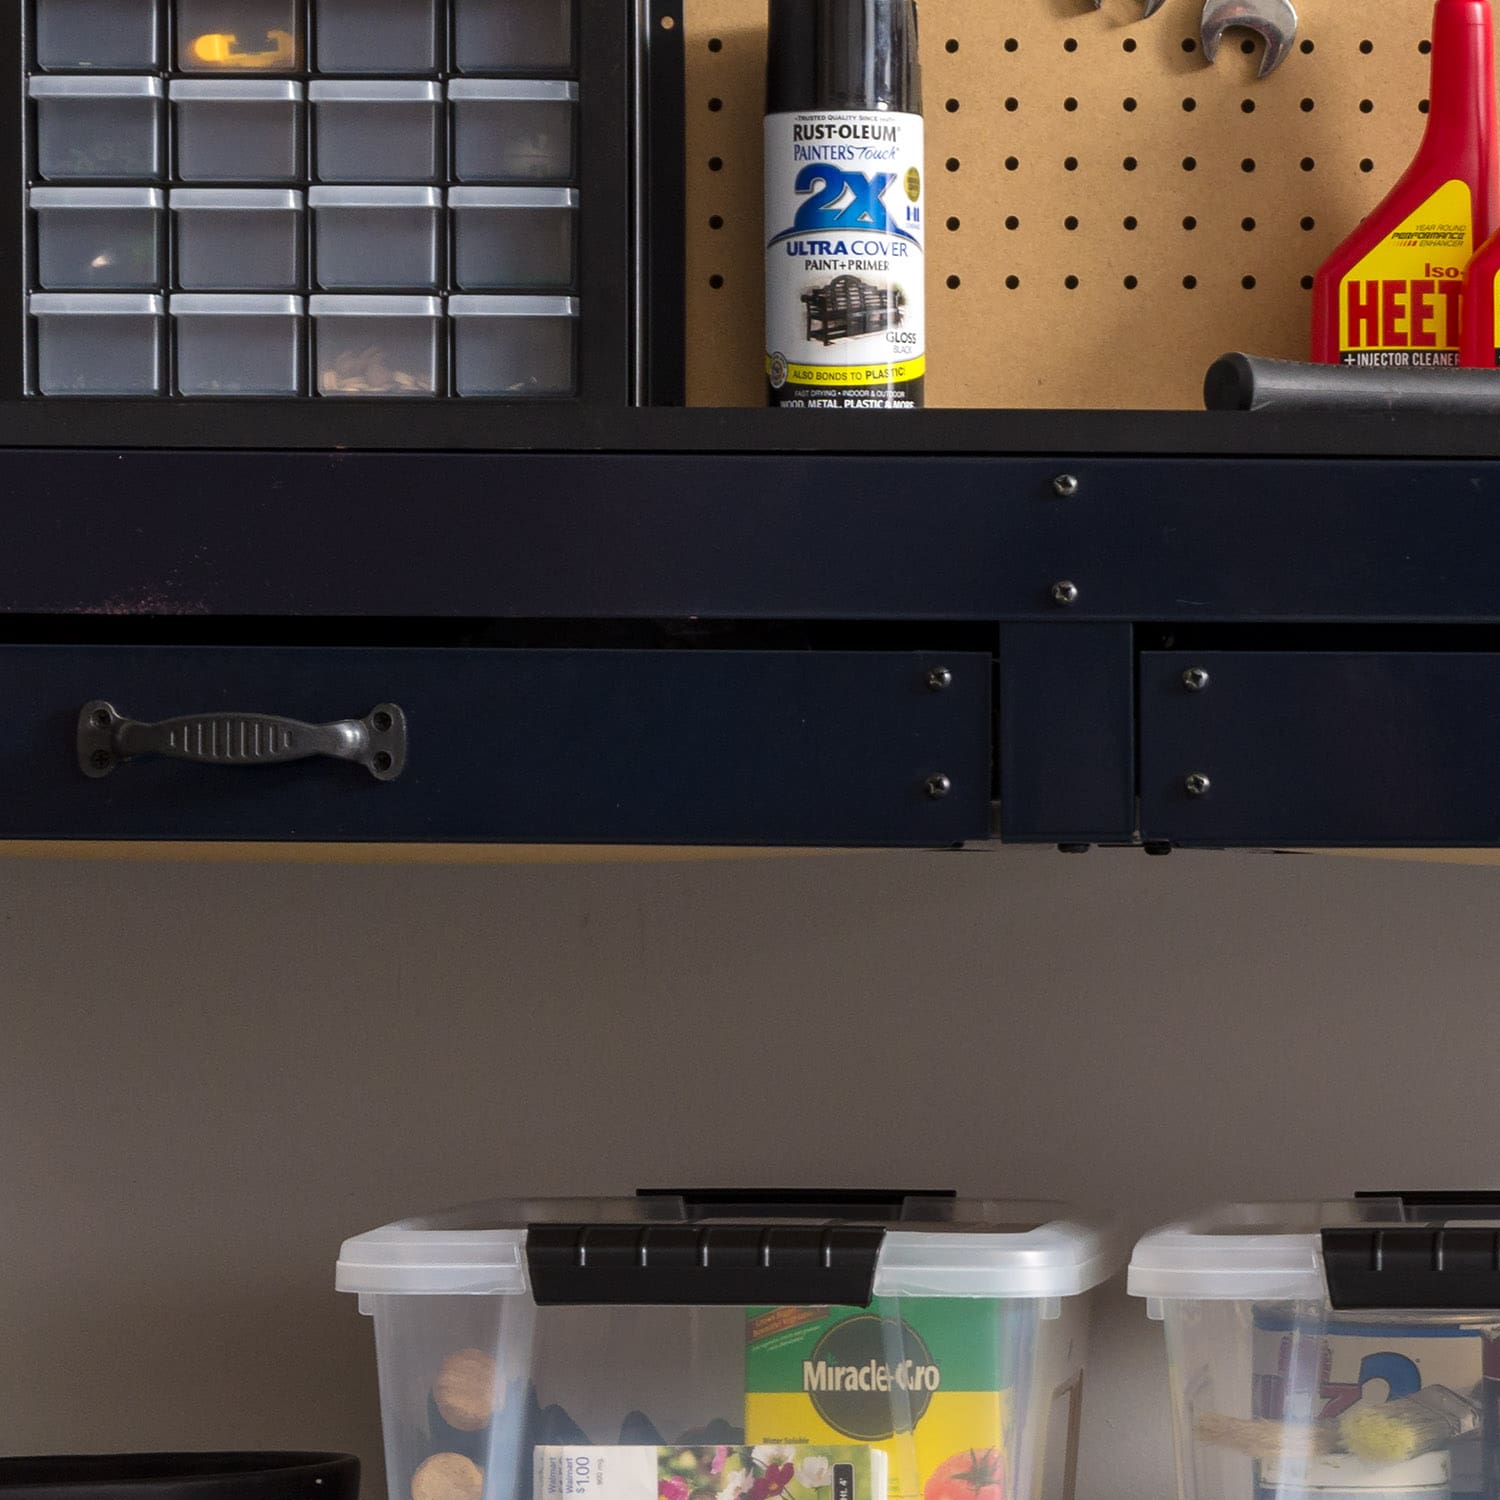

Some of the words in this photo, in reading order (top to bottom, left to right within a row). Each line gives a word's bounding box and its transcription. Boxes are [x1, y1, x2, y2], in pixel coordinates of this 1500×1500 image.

[793, 124, 897, 142] RUST-OLEUM
[852, 146, 896, 160] Touch
[795, 163, 897, 231] 2X
[1391, 232, 1465, 240] PERFORMANCE
[786, 240, 848, 256] ULTRA
[851, 240, 908, 256] COVER
[1347, 280, 1463, 347] HEET
[886, 331, 917, 344] GLOSS
[893, 345, 913, 354] BLACK
[793, 371, 814, 380] ALSO
[816, 372, 847, 381] BONDS
[850, 372, 862, 380] TO
[565, 1457, 574, 1494] Walmart
[576, 1456, 590, 1494] $1.00
